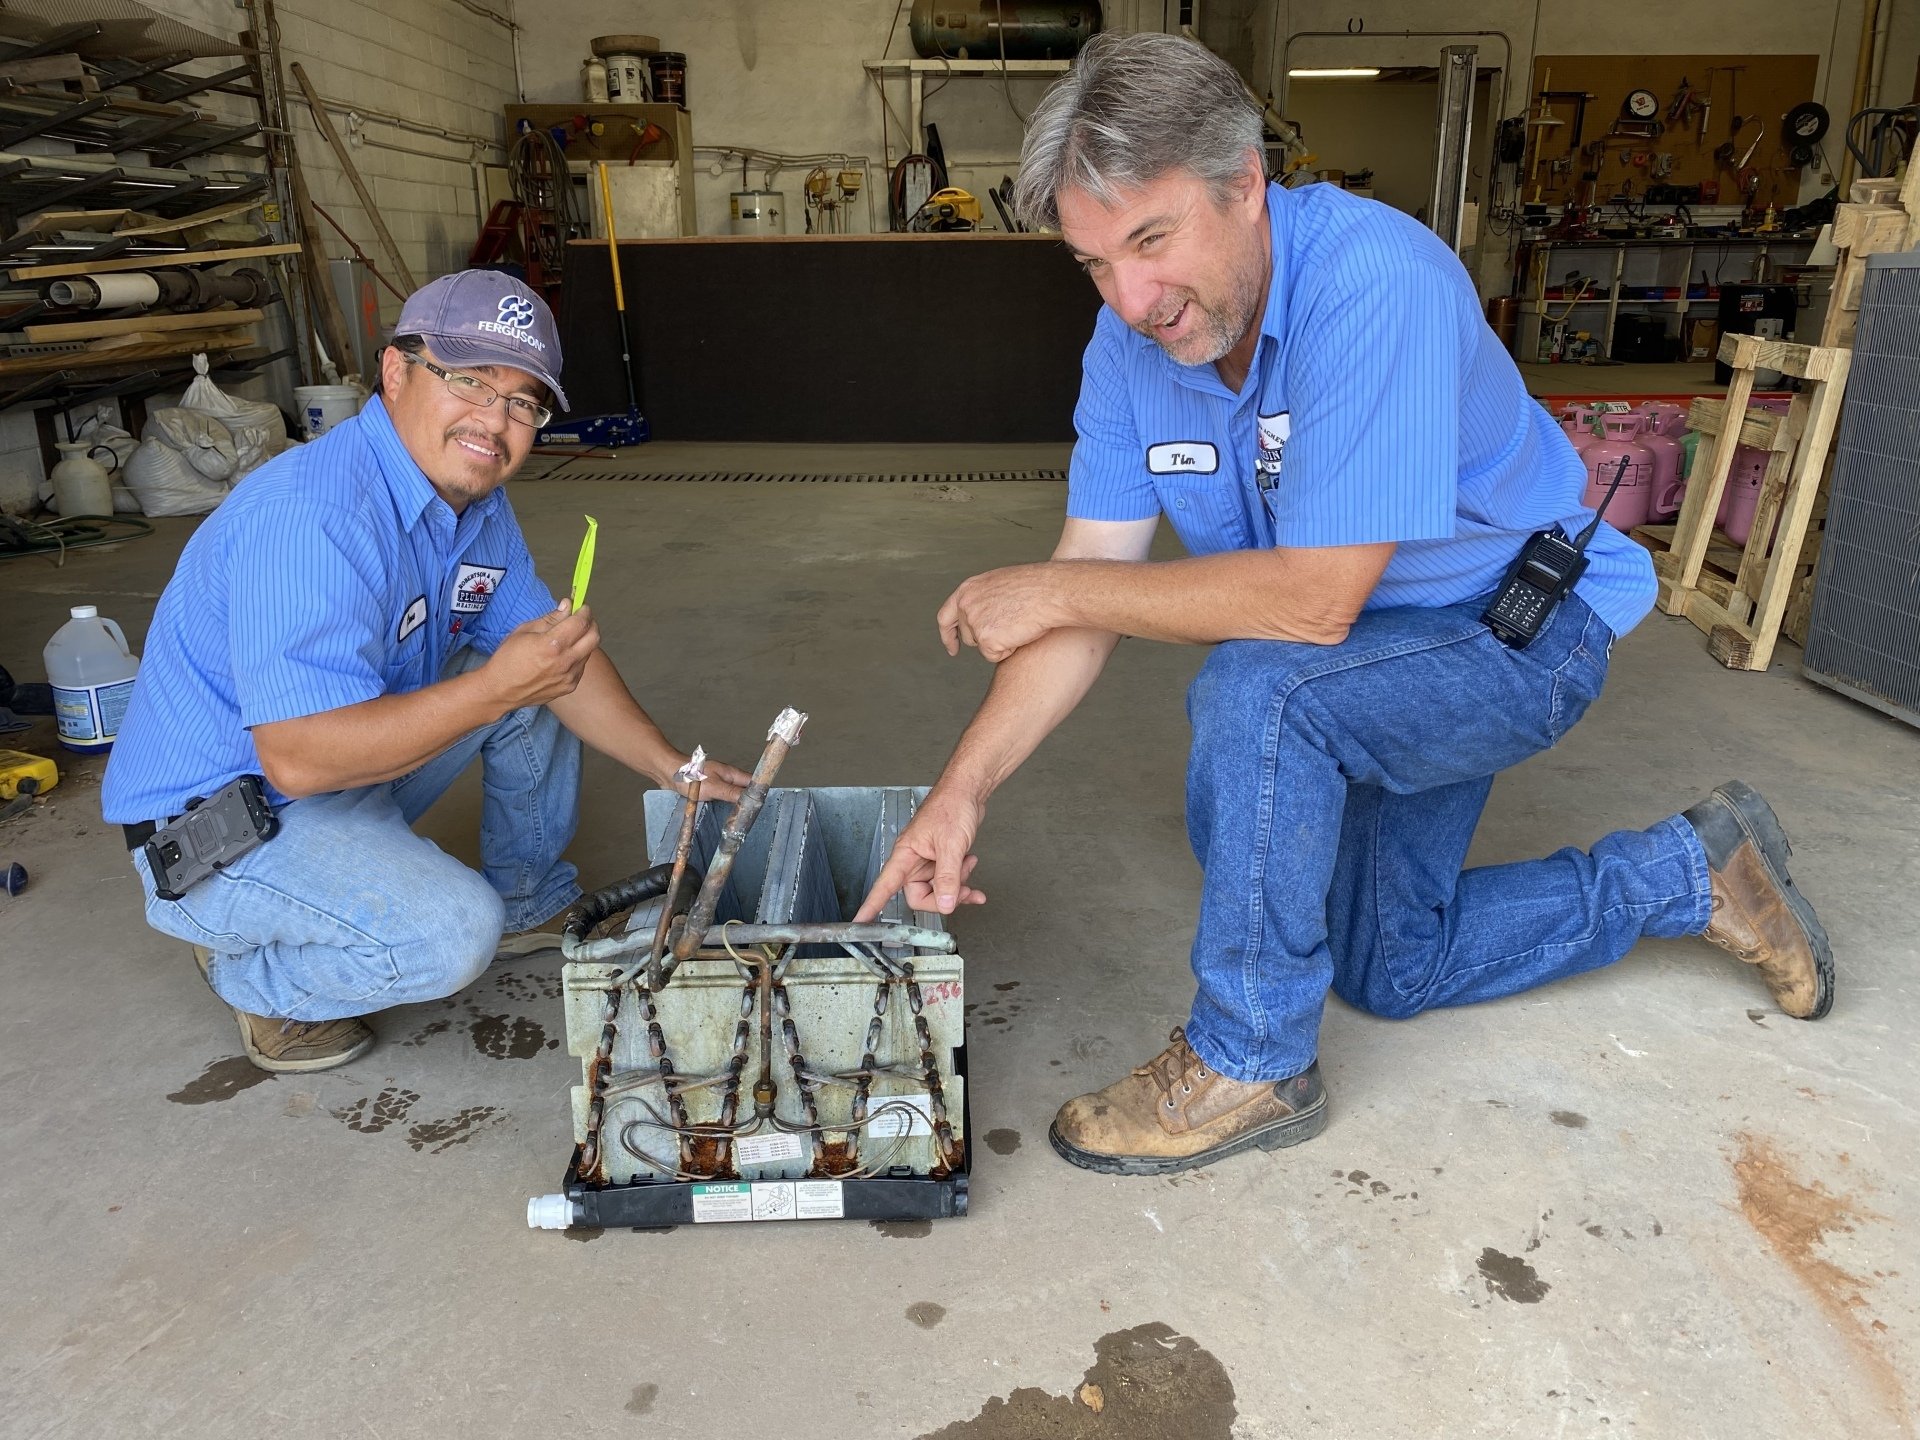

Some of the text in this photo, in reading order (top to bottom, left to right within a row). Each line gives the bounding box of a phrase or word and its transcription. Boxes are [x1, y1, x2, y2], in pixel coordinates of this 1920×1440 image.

[478, 320, 543, 351] FERGUSON
[1171, 453, 1196, 466] Tim
[458, 572, 487, 590] ROBERTSON
[705, 1184, 739, 1193] NOTICE
